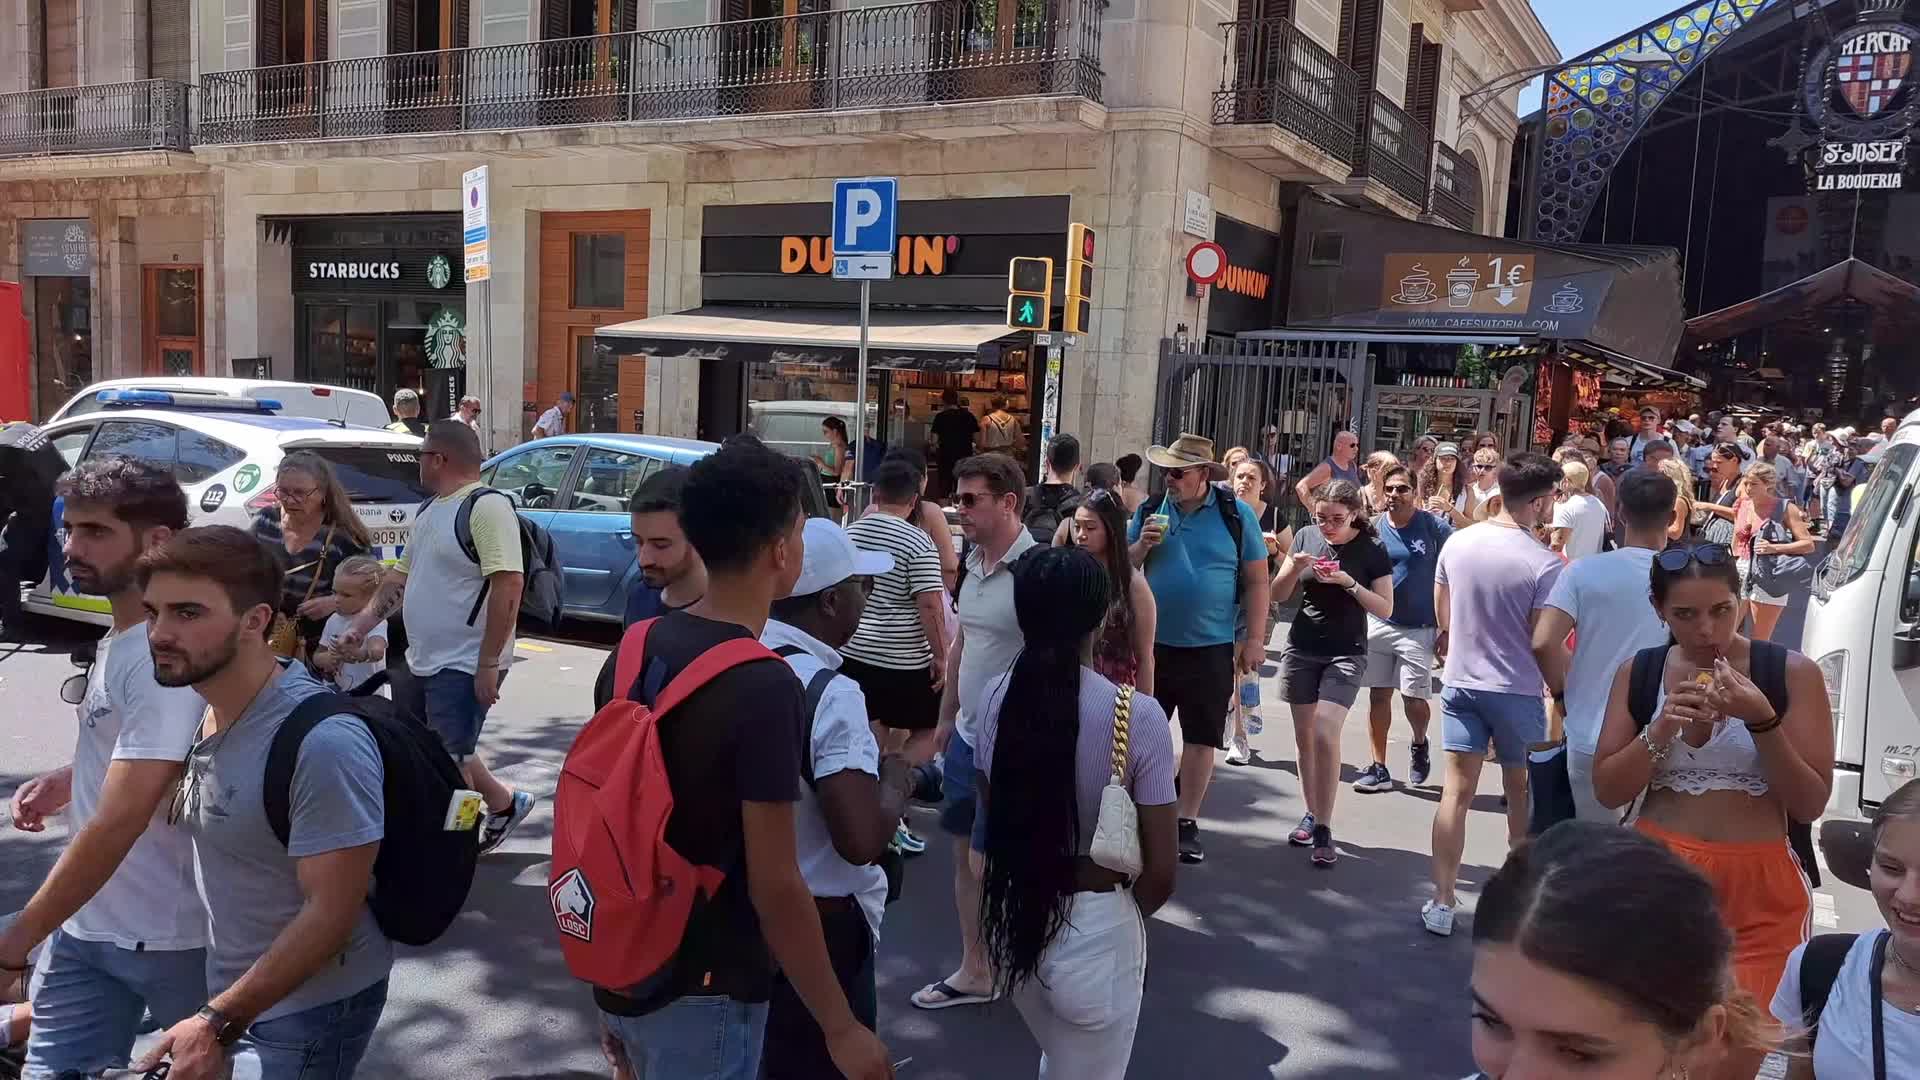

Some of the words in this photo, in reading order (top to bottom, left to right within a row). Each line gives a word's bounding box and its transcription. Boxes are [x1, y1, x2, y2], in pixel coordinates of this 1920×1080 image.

[1841, 31, 1912, 56] MERCAT
[1841, 142, 1903, 163] JOSEP
[1817, 175, 1834, 190] LA
[1836, 172, 1902, 190] BOQUERIA
[845, 188, 882, 246] P
[780, 235, 960, 275] DUIN'
[309, 262, 400, 279] STARBUCKS
[1486, 256, 1526, 288] 1€
[386, 453, 417, 463] POLICI
[204, 490, 224, 502] 112
[372, 531, 396, 545] 909
[562, 917, 586, 936] LOSC
